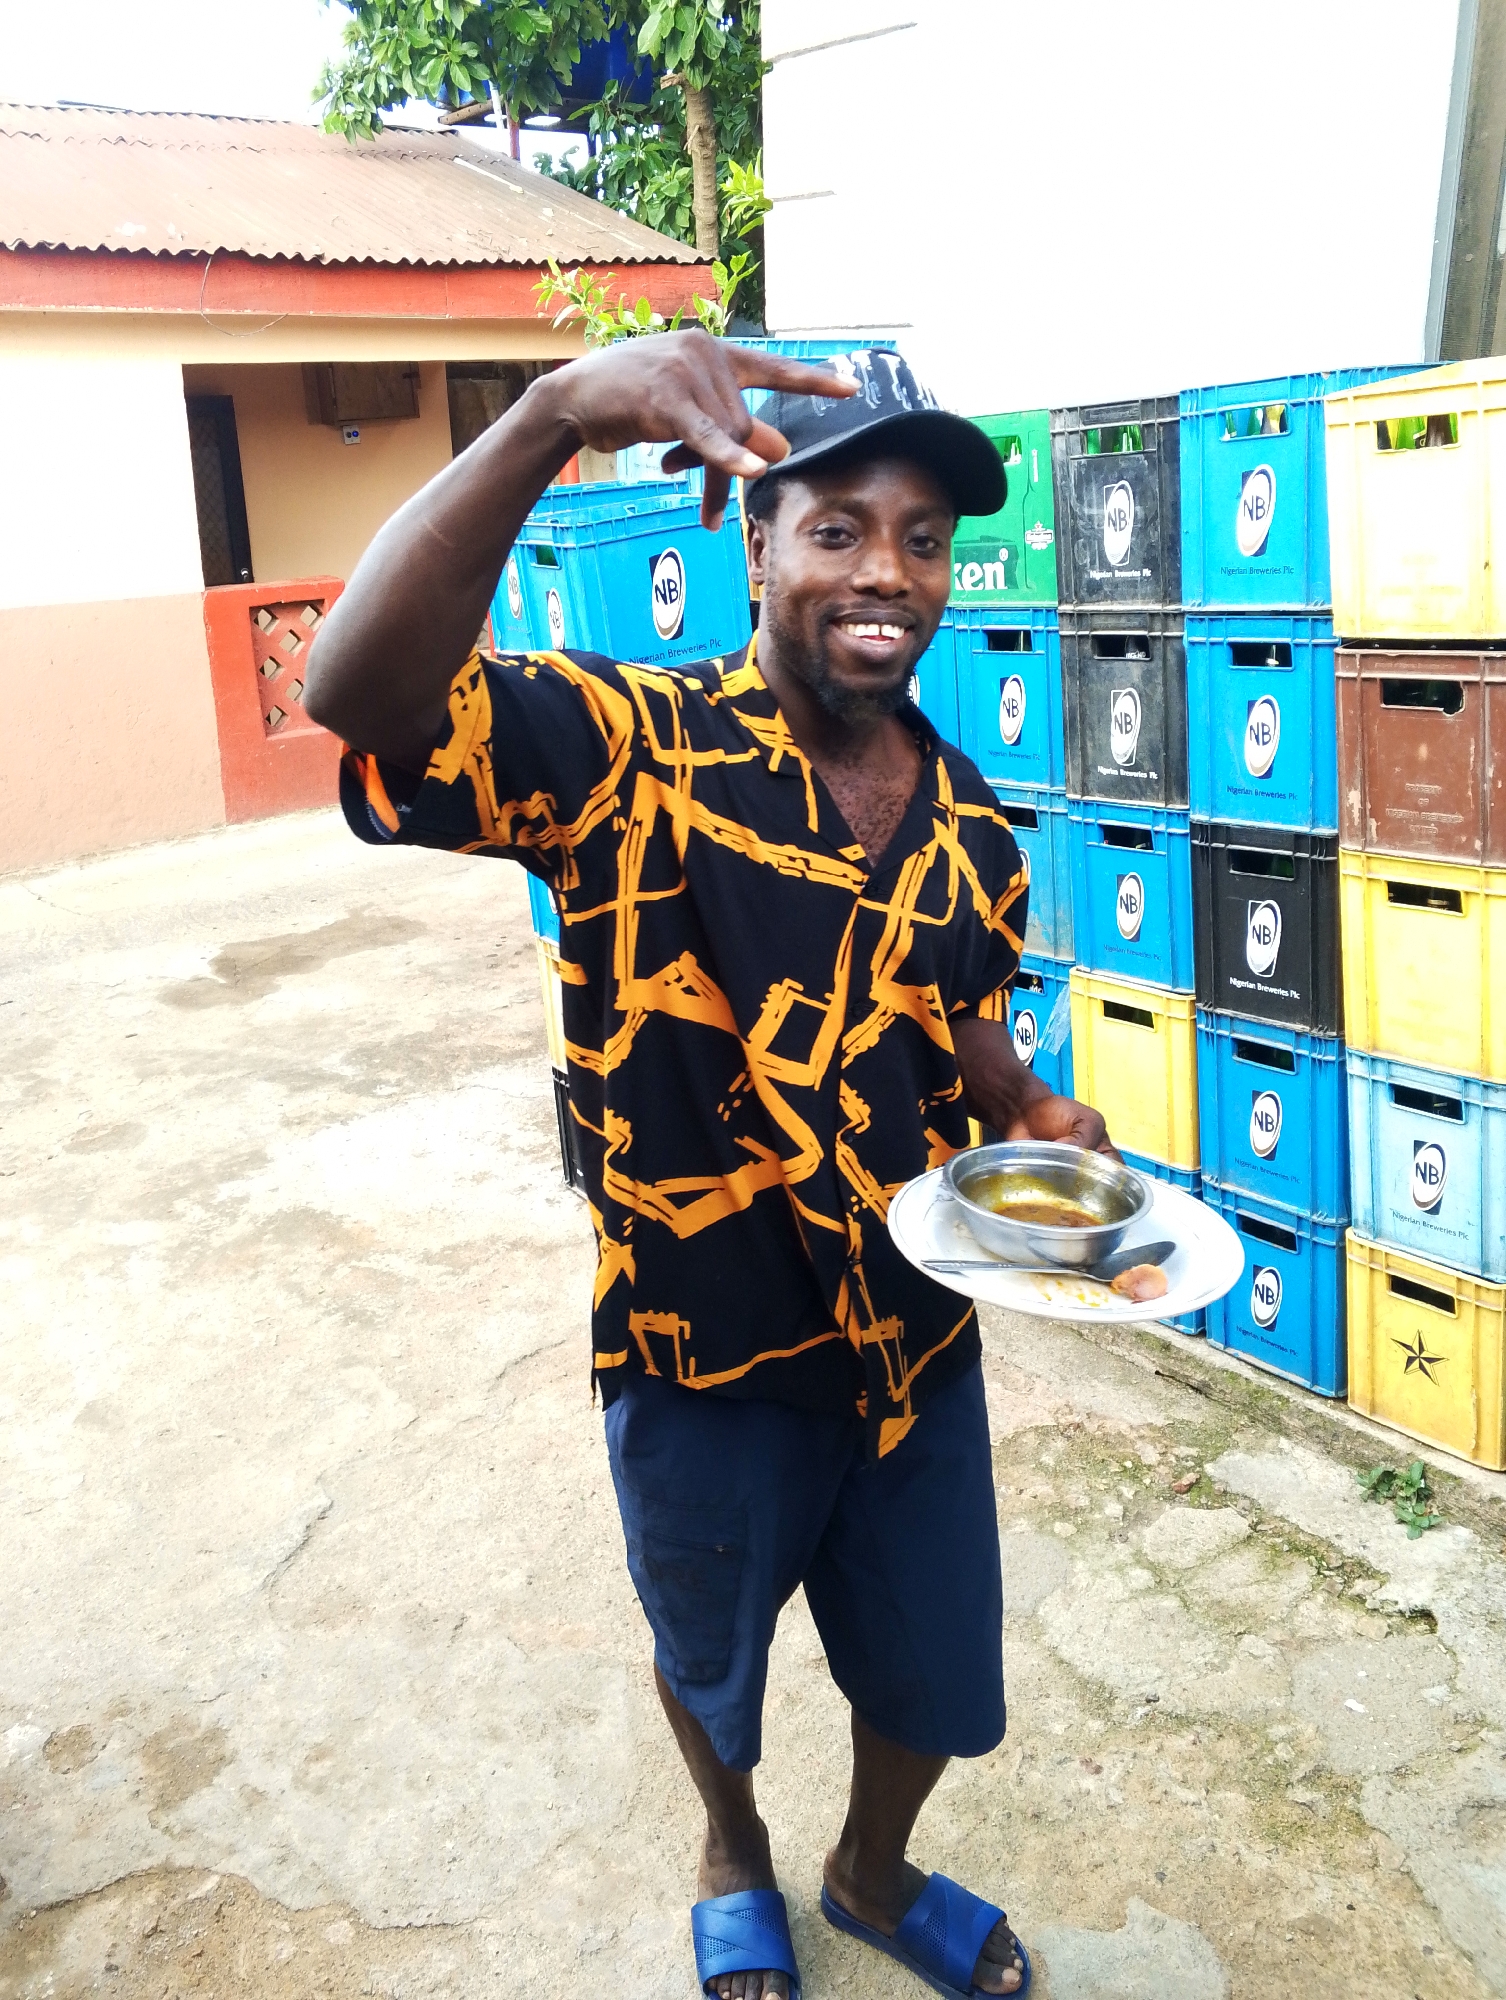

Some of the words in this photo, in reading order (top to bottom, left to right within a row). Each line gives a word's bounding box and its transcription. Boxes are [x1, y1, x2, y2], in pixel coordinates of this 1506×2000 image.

[1244, 495, 1266, 521] NB
[1107, 508, 1128, 532] NB
[1220, 567, 1247, 576] Nigerian
[1249, 566, 1281, 575] Breweries
[508, 575, 519, 595] NB
[654, 578, 679, 606] NB
[667, 643, 707, 658] Breweries
[709, 638, 722, 648] Plc
[1002, 698, 1020, 718] NB
[1114, 711, 1133, 735] NB
[1249, 722, 1272, 746] NB
[1119, 768, 1147, 779] Breweries
[1226, 785, 1252, 796] Nigerian
[1254, 789, 1286, 799] Breweries
[1119, 893, 1138, 914] NB
[1252, 924, 1272, 946] NB
[1229, 976, 1256, 989] Nigerian
[1257, 982, 1289, 997] Breweries
[1290, 990, 1301, 1000] Plc
[1016, 1027, 1032, 1046] NB
[1254, 1110, 1275, 1133] NB
[1234, 1157, 1259, 1171] Nigerian
[1260, 1166, 1290, 1180] Breweries
[1415, 1161, 1440, 1186] NB
[1392, 1210, 1421, 1226] Nigerian
[1422, 1220, 1457, 1237] Breweries
[1458, 1230, 1470, 1241] Plc
[1254, 1283, 1275, 1306] NB
